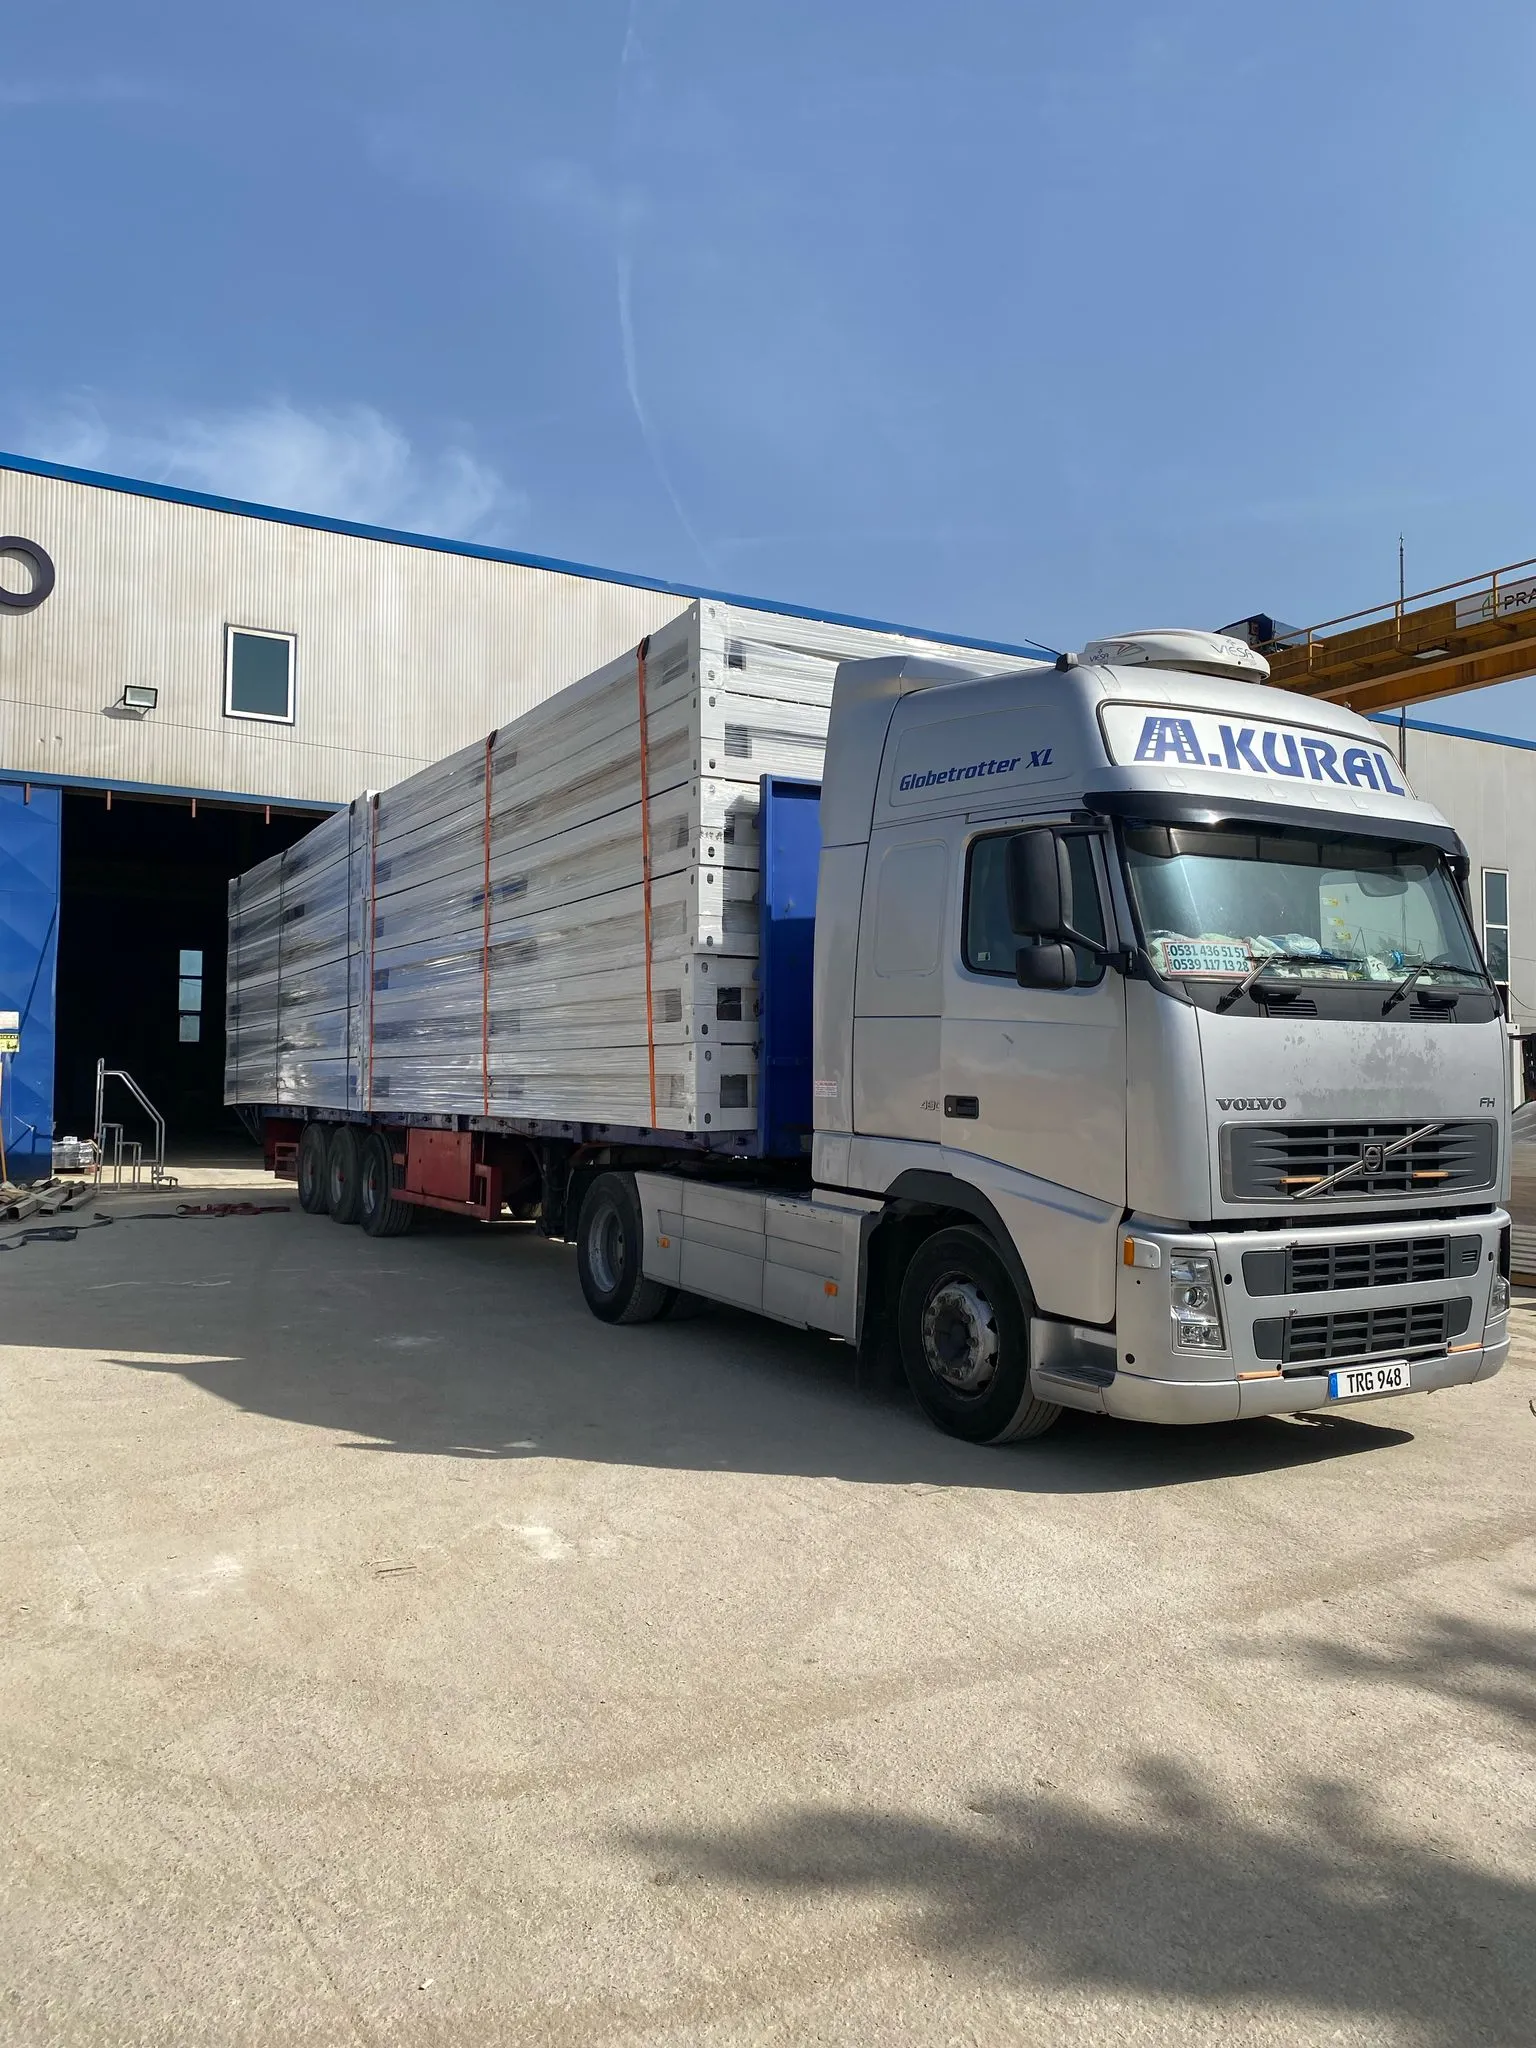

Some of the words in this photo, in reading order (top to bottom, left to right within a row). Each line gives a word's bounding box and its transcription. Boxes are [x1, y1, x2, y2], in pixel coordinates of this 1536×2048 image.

[1210, 644, 1254, 660] VIESA
[1134, 717, 1405, 797] A.KURAL
[900, 757, 1021, 791] Globetrotter
[1026, 749, 1053, 768] XL
[1170, 945, 1198, 956] 0531
[1200, 945, 1220, 957] 436
[1222, 946, 1234, 957] 51
[1234, 947, 1246, 958] 51
[1173, 959, 1201, 970] 0539
[1203, 960, 1220, 970] 117
[1223, 960, 1235, 971] 13
[1236, 961, 1250, 972] 28
[1216, 1097, 1287, 1111] VOLVO
[1479, 1097, 1496, 1108] FH
[1347, 1371, 1374, 1393] TRG
[1377, 1368, 1402, 1389] 948
